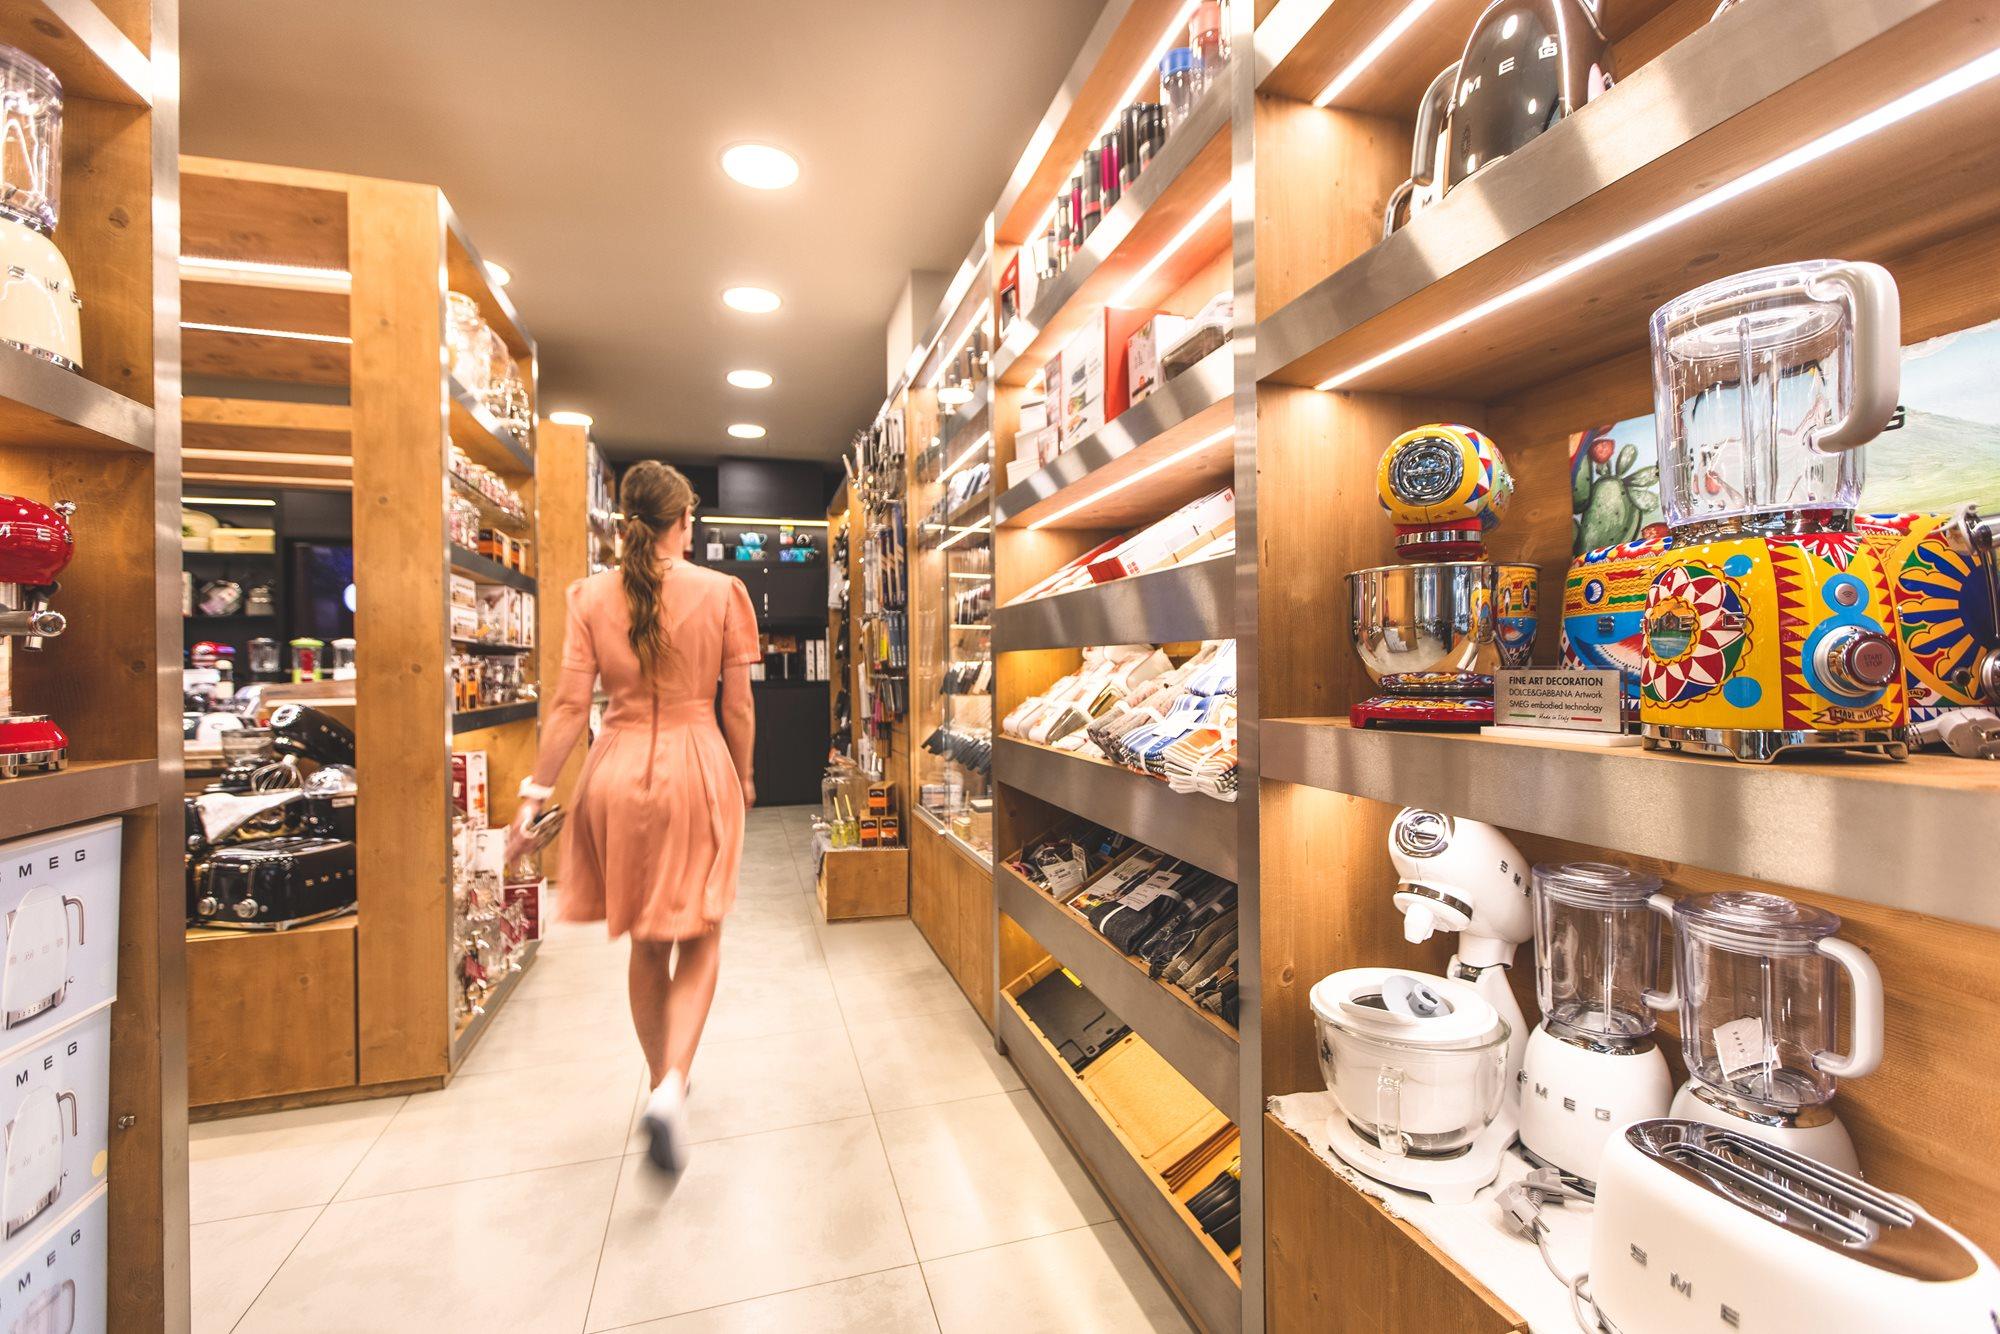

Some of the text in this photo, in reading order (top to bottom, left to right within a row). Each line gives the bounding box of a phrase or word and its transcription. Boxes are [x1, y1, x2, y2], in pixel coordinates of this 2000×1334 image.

[1509, 676, 1603, 687] FINE ART DECORATION
[1509, 688, 1602, 699] DOLCE&GABBANA Artwork
[1509, 700, 1603, 714] SMEG embodied technology
[1834, 708, 1855, 719] MADE
[0, 849, 86, 880] MEG
[1500, 859, 1532, 898] SME
[0, 1229, 81, 1309] MEG
